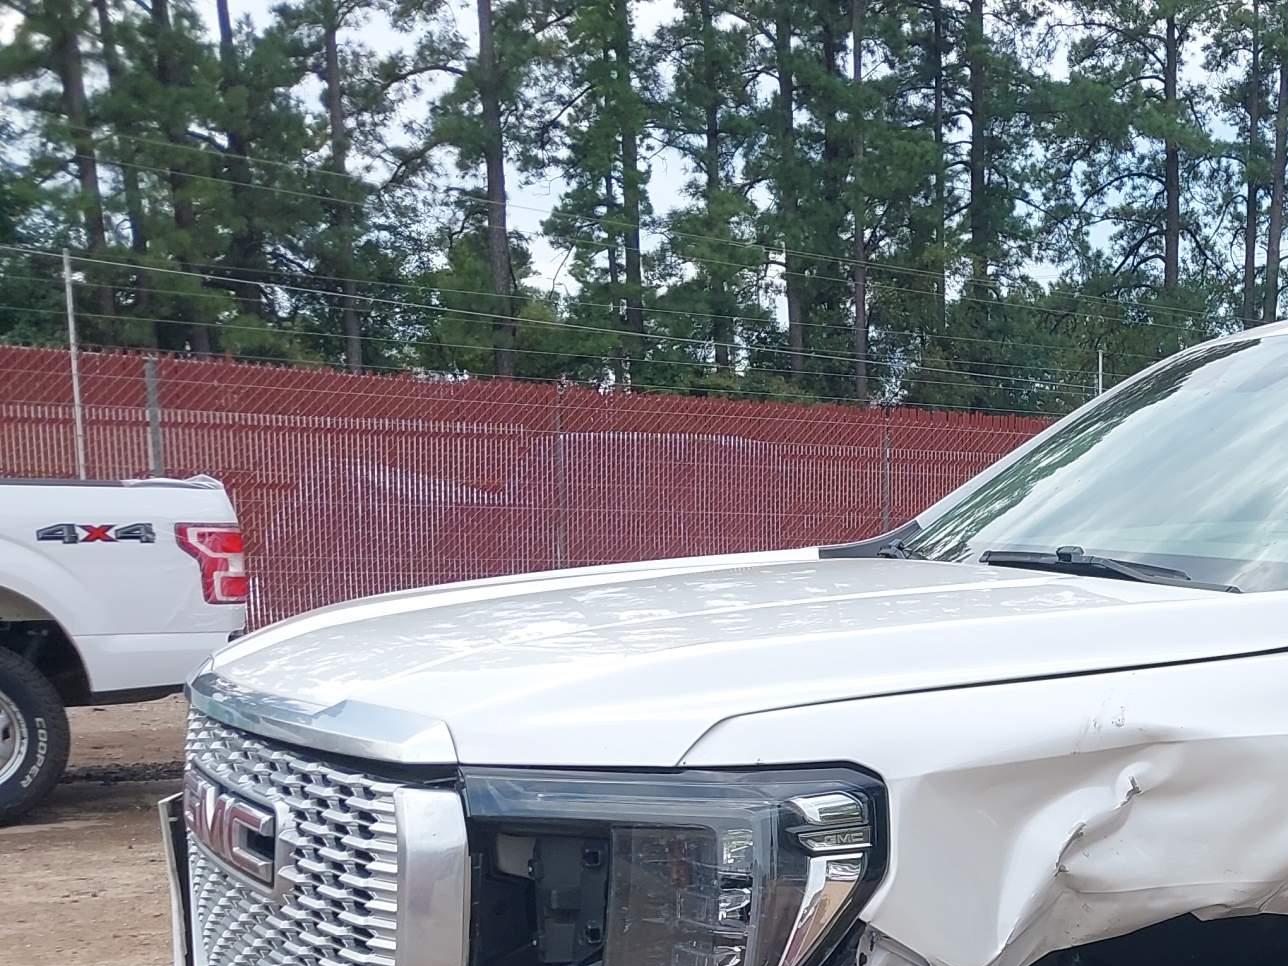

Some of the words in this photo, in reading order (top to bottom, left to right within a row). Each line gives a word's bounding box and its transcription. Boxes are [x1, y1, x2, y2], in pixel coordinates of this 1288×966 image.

[20, 717, 48, 788] COOPER
[184, 770, 274, 884] GMC
[824, 832, 864, 845] GMC
